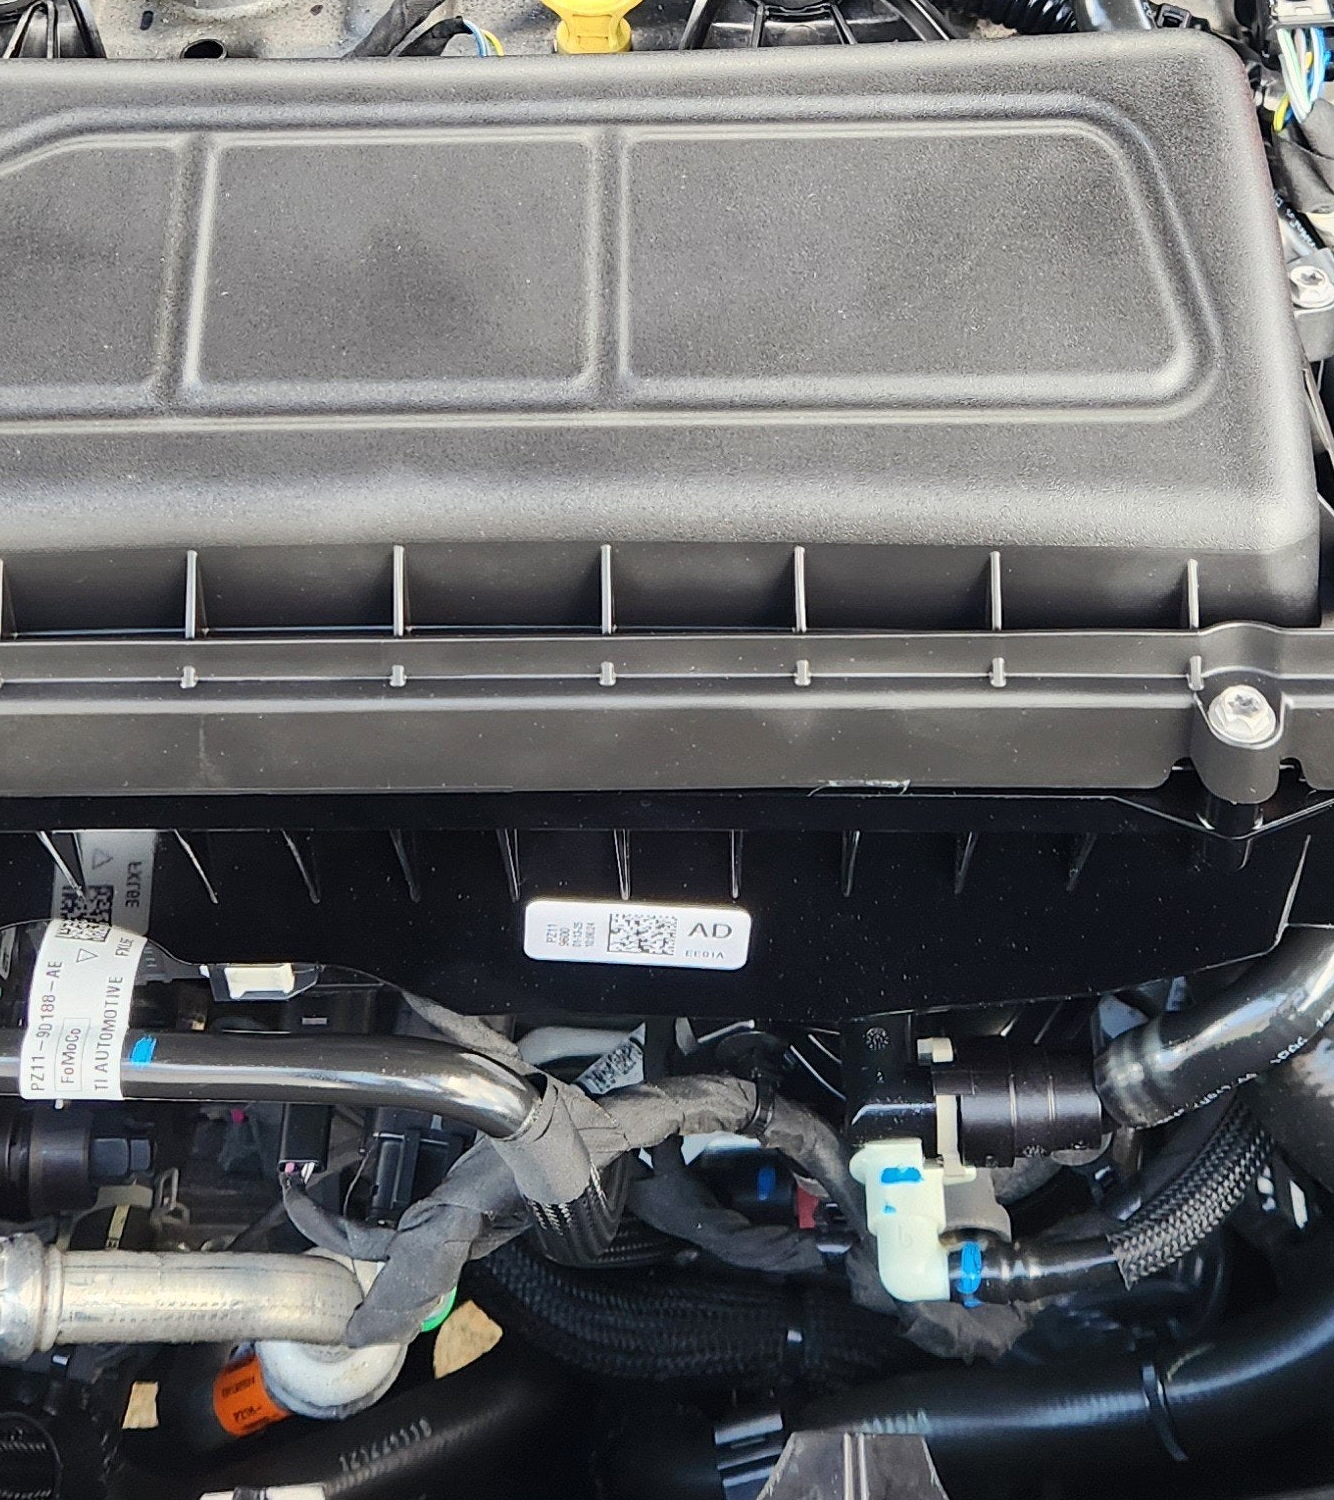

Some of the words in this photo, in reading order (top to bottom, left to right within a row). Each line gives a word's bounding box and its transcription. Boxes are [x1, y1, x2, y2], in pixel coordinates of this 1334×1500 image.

[687, 922, 733, 939] AD
[30, 960, 64, 1092] PZ11-9D188-AE
[60, 1026, 82, 1085] FoMoCo
[94, 975, 124, 1073] AUTOMOTIVE
